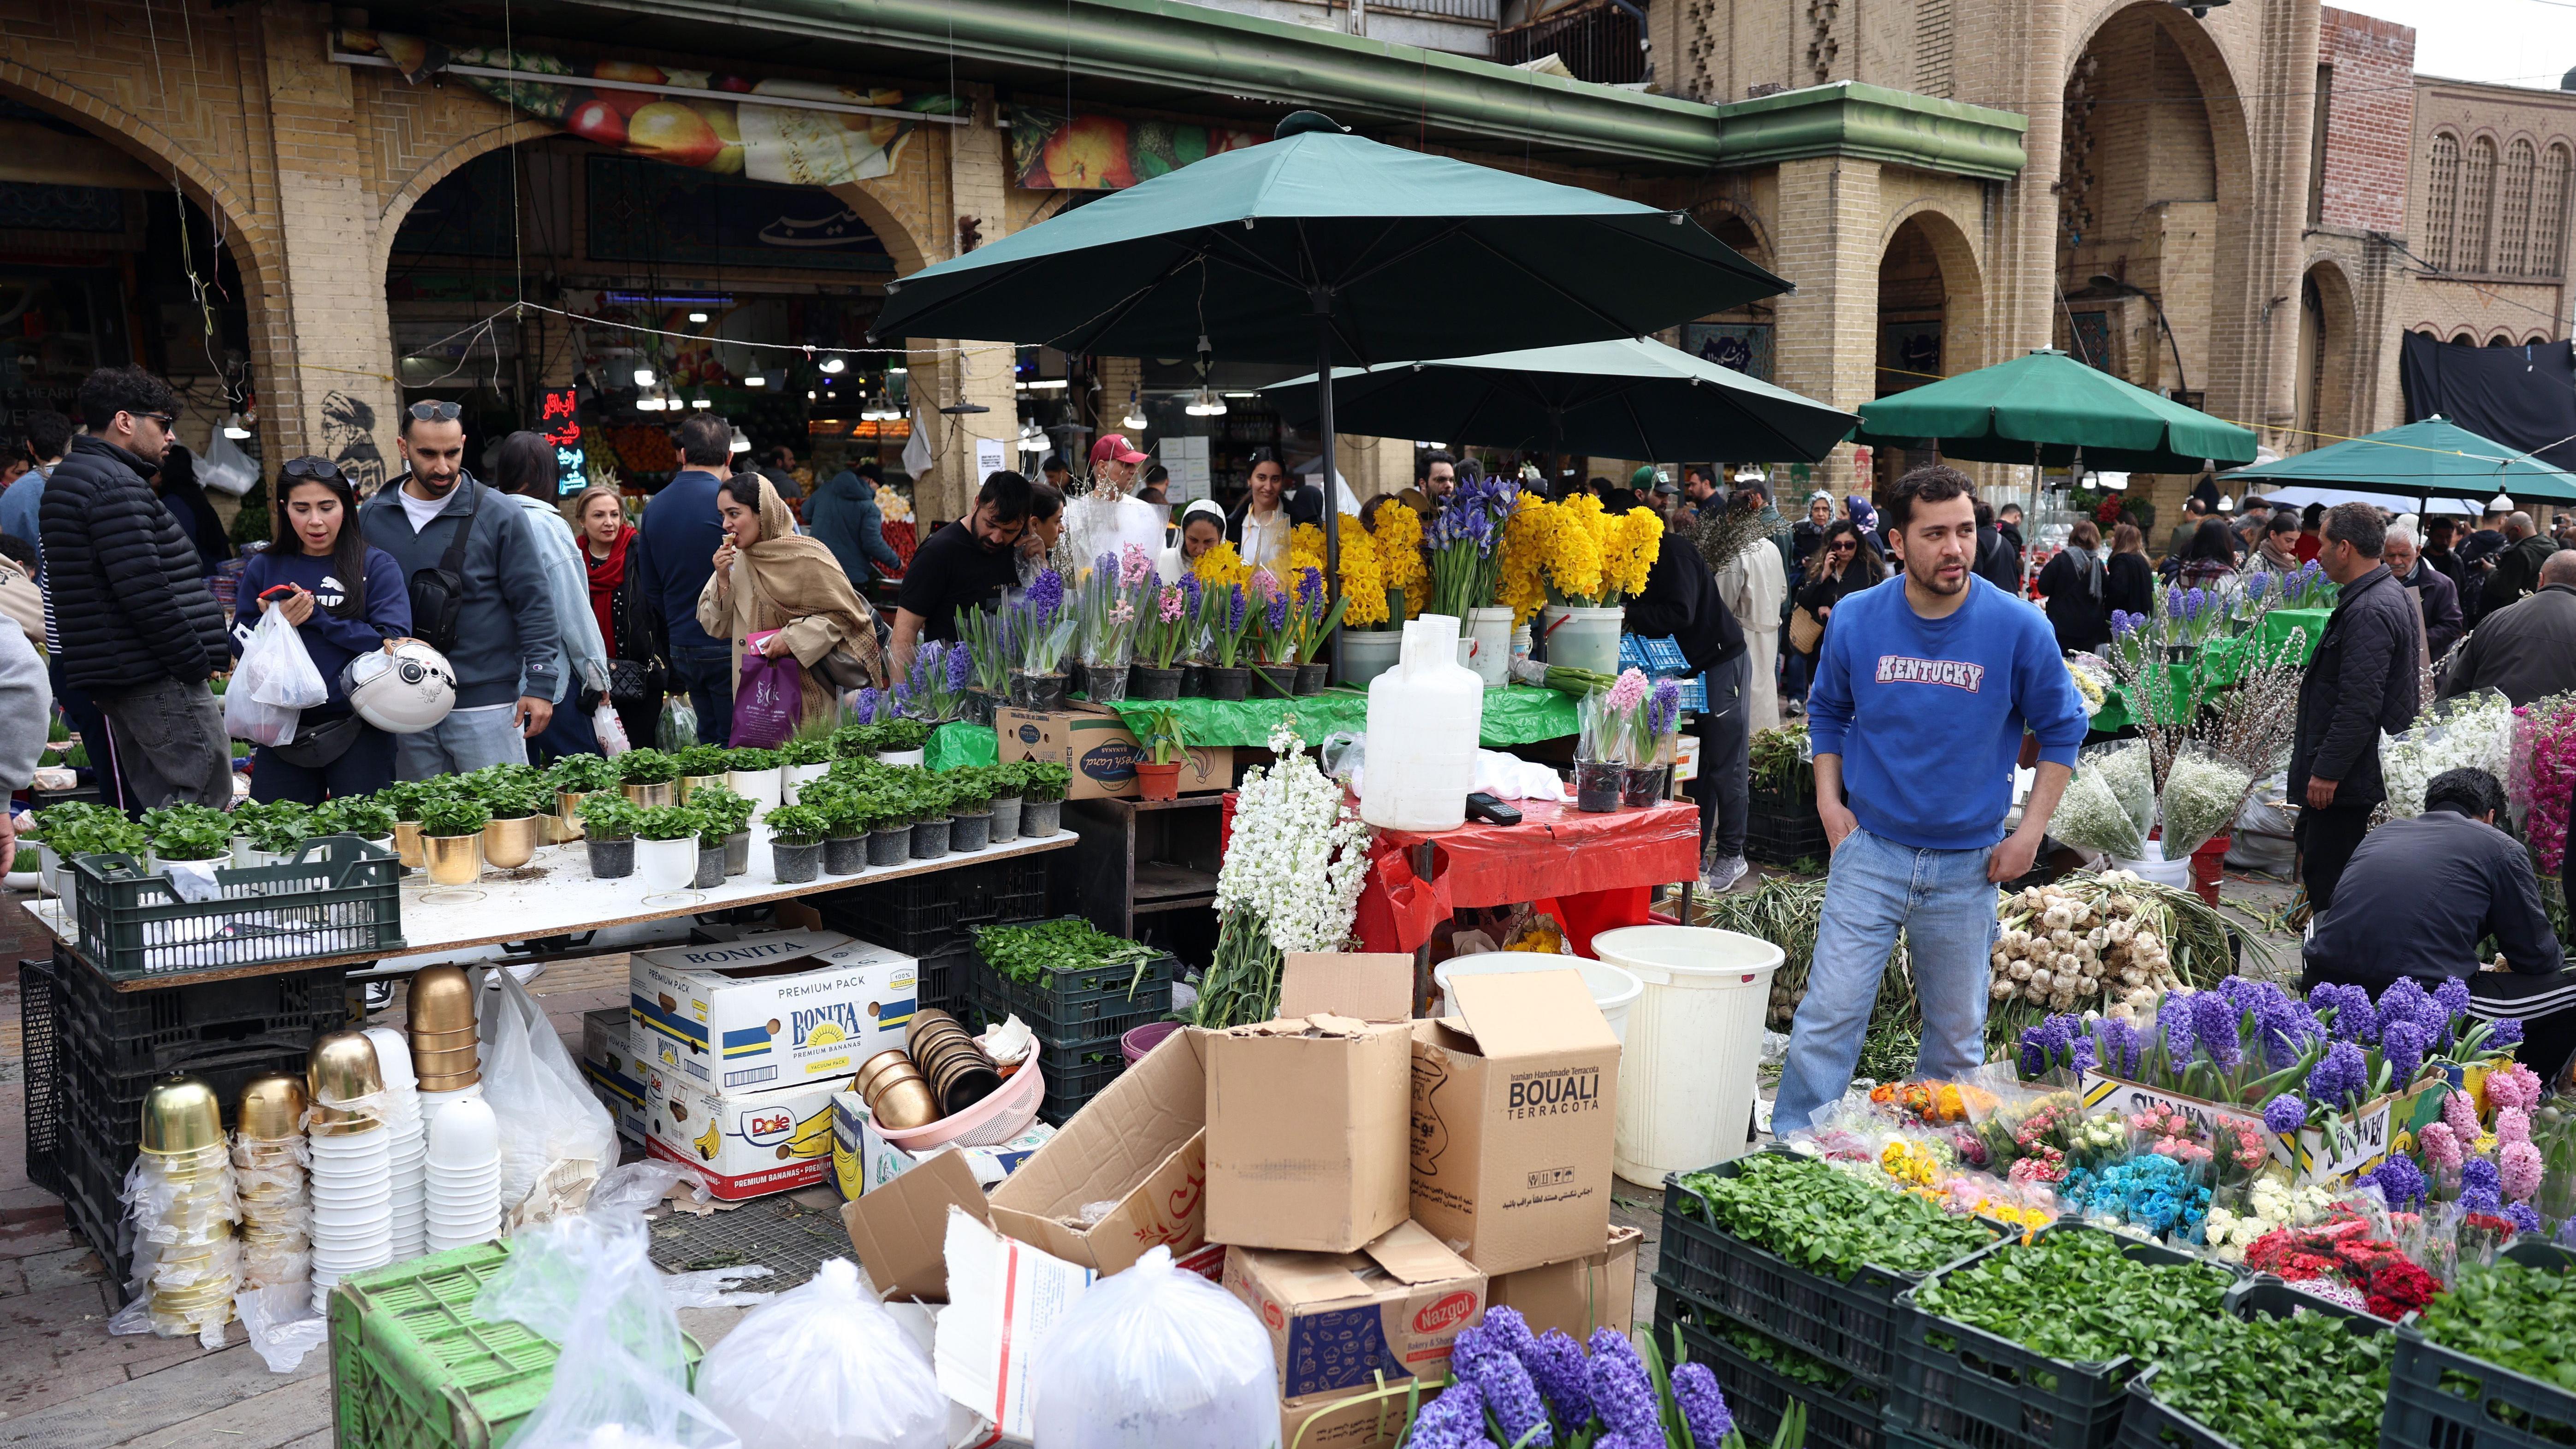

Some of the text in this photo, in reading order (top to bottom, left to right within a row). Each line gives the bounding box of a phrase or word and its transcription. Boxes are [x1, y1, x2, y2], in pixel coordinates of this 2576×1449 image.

[559, 390, 575, 418] آب
[1877, 656, 1982, 691] KENTUCKY
[1084, 757, 1113, 770] Land
[683, 941, 806, 964] BONITA
[648, 969, 673, 987] PREMIUM
[674, 980, 690, 994] PACK
[778, 976, 865, 999] PREMIUM PACK
[790, 1002, 861, 1046] BONITA
[657, 1037, 680, 1065] BONITA
[793, 1041, 861, 1059] PREMIUM BANANAS
[811, 1062, 832, 1070] VACUUM
[1510, 1065, 1599, 1082] Iranian Handmade Terracota
[650, 1073, 662, 1090] Dole
[1509, 1074, 1599, 1108] BOUALI
[1508, 1100, 1599, 1120] TERRACOTA
[752, 1114, 790, 1134] Dole
[649, 1141, 663, 1156] PREMIUM
[663, 1151, 679, 1165] BANANAS
[734, 1162, 831, 1188] PREMIUM BANANAS PREMIU
[1516, 1198, 1532, 1207] مراقب
[1544, 1194, 1558, 1202] هستند
[1558, 1190, 1577, 1201] شکستنی
[1577, 1187, 1593, 1198] اجناس
[1503, 1200, 1516, 1210] باشید
[1421, 1295, 1470, 1330] Nazgol
[1408, 1342, 1428, 1351] Bakery
